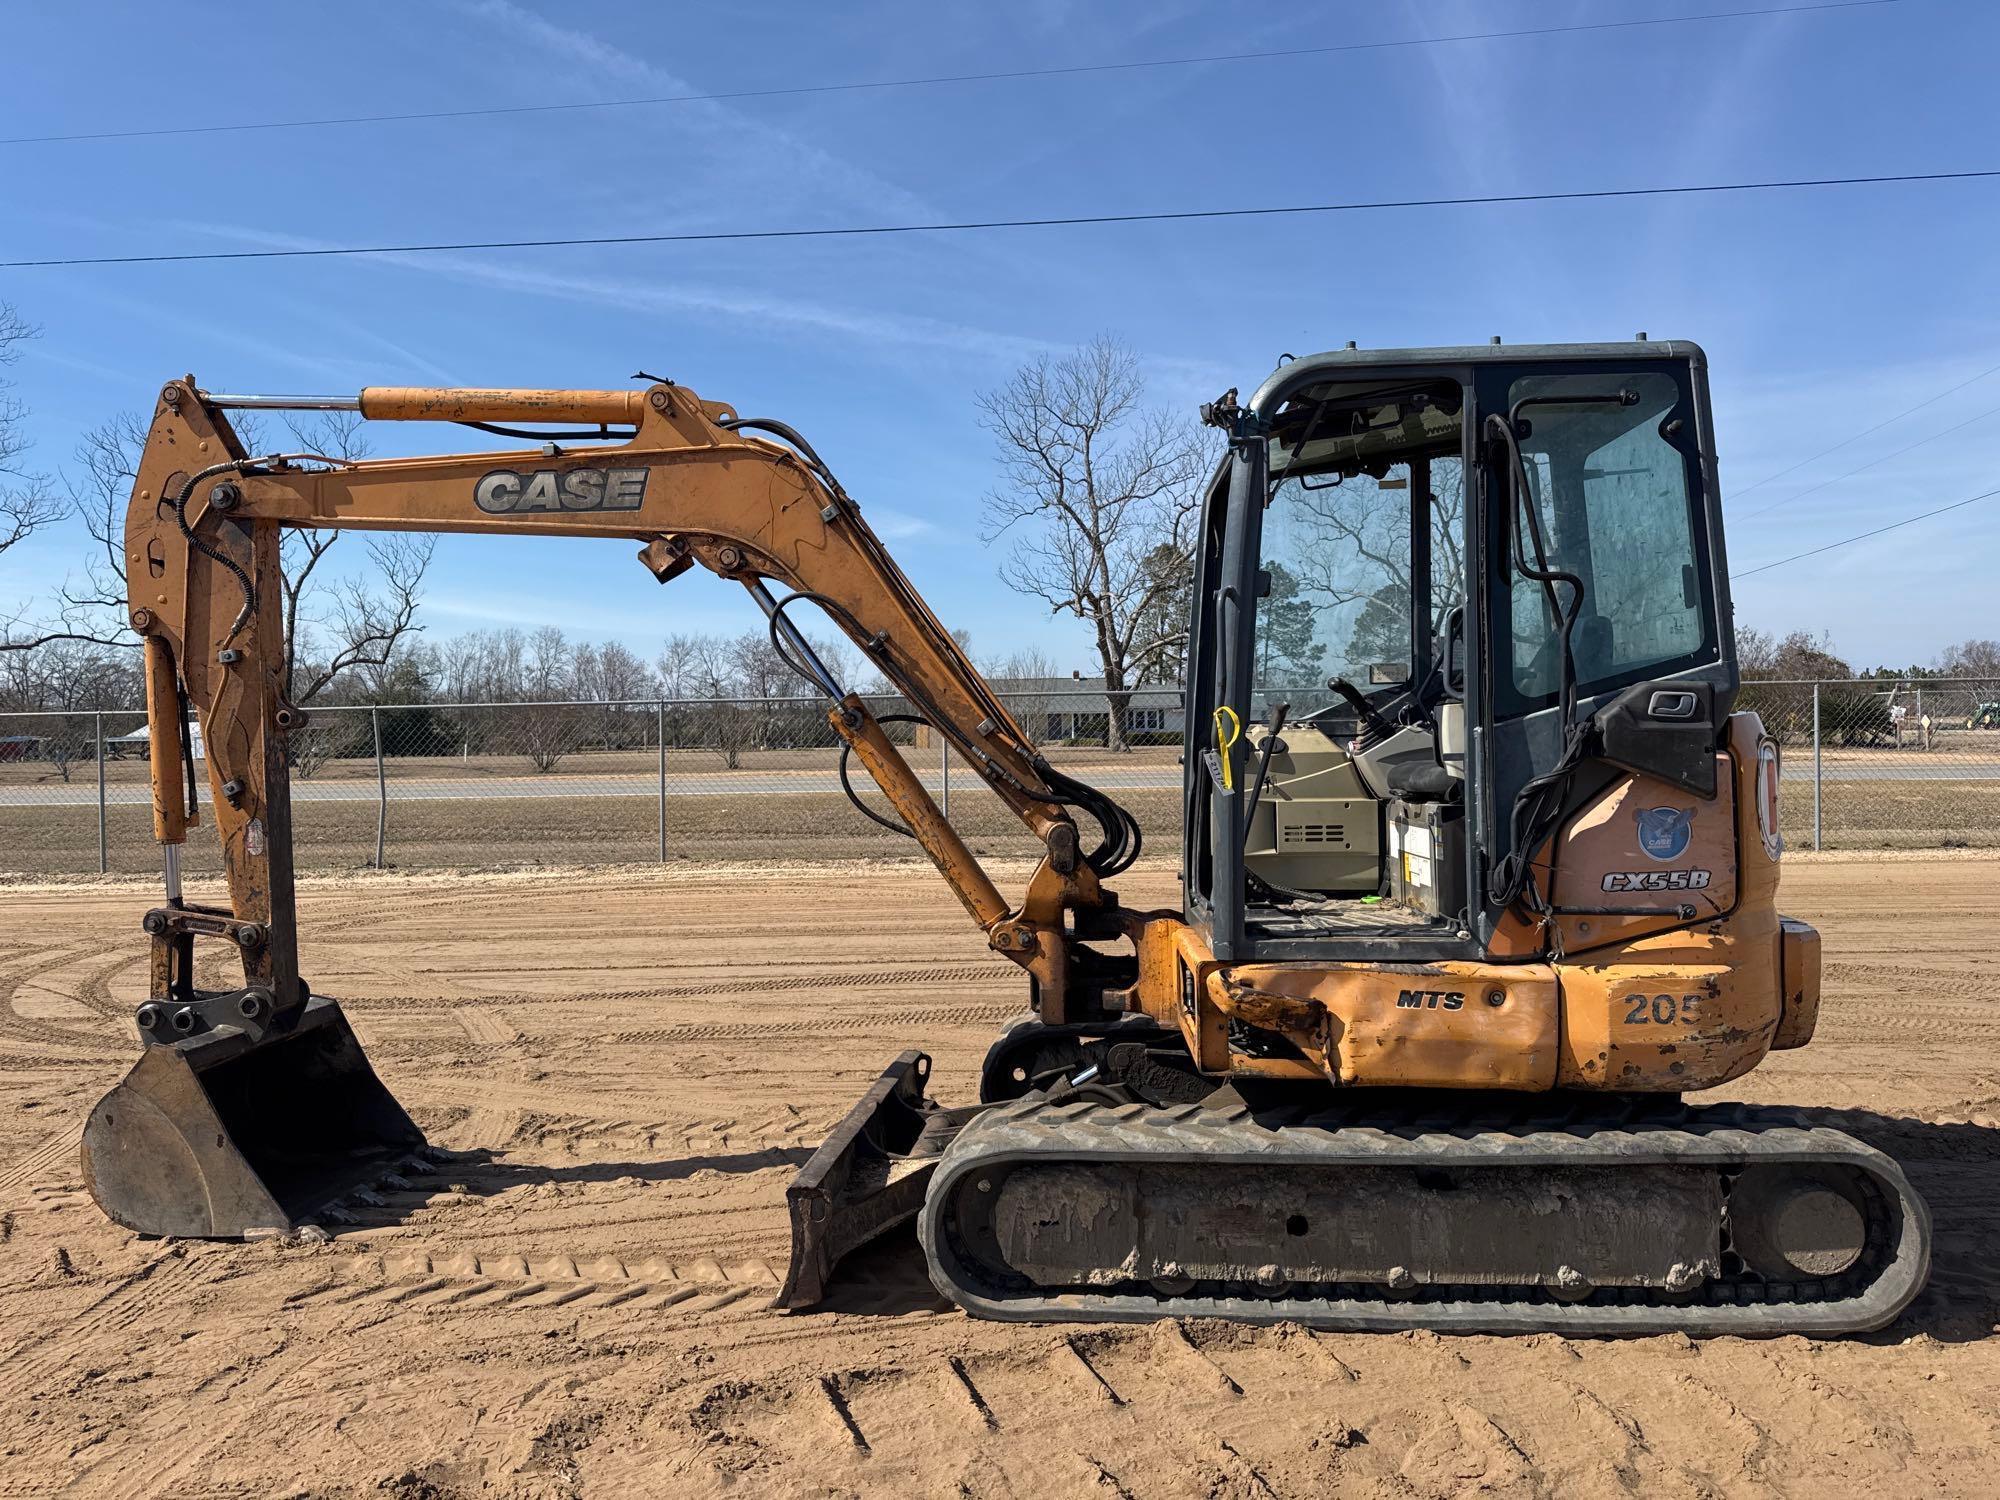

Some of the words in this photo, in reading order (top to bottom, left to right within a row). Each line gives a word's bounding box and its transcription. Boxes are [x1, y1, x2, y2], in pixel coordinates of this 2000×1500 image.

[476, 468, 649, 512] CASE
[1601, 870, 1712, 892] CX55B
[1396, 990, 1466, 1011] MTS
[1623, 993, 1702, 1025] 205
